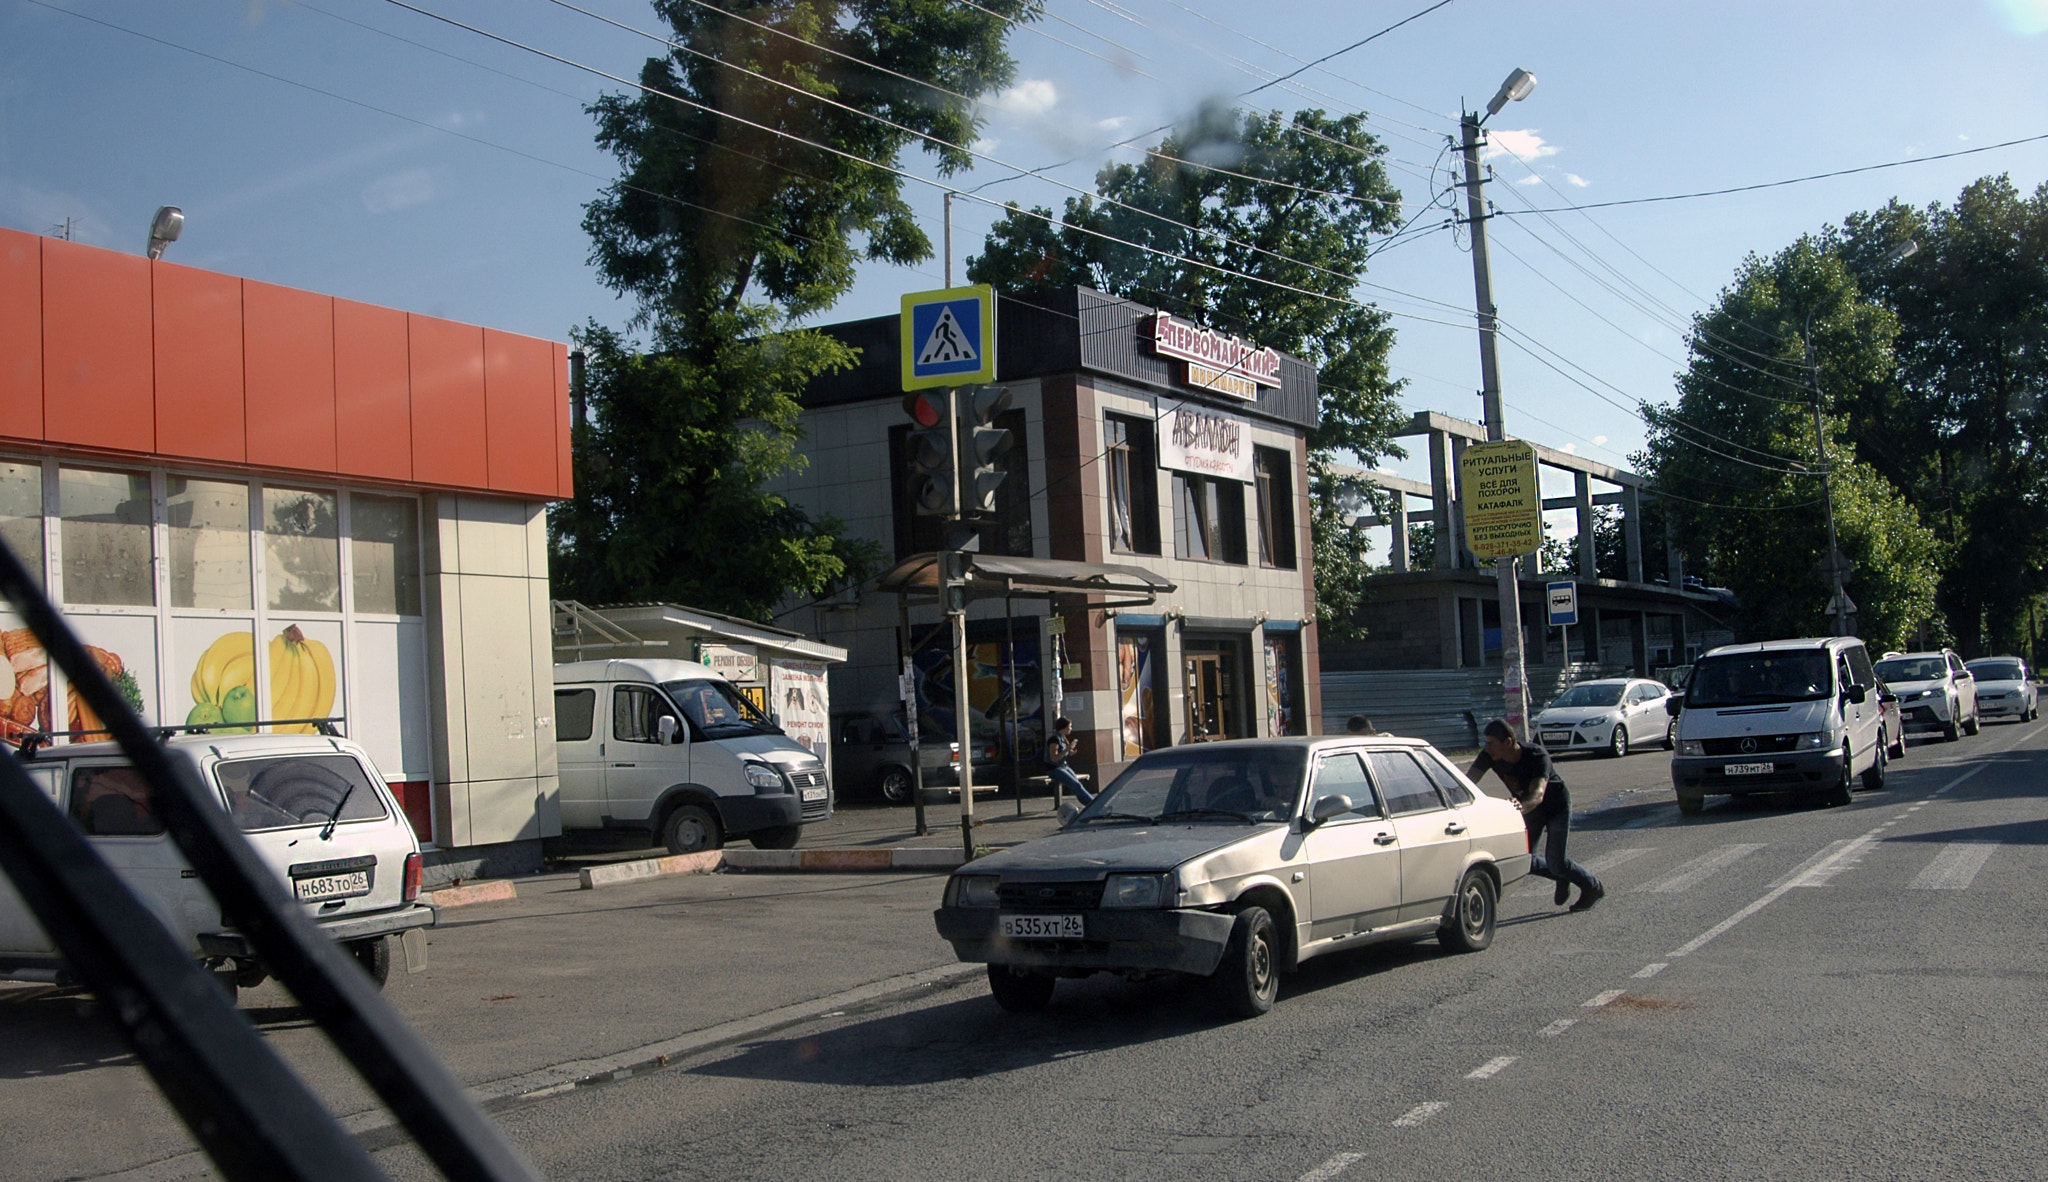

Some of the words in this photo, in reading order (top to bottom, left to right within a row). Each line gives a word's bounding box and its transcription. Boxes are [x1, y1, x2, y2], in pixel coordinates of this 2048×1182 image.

[1168, 324, 1272, 376] ПЕРВОМАЙСКИЙ
[1191, 366, 1255, 399] МИНИМАРКЕТ
[1172, 407, 1239, 459] АВАЛЛОН
[1463, 452, 1531, 467] РИТУАЛЬНЫЕ
[1479, 465, 1517, 477] УСЛУГИ
[1500, 479, 1518, 488] ДЛЯ
[1478, 487, 1521, 498] ПОХОРОН
[1478, 499, 1524, 511] КАТАФАЛК
[1473, 522, 1532, 534] КРУГЛОСУТОЧНО
[1490, 529, 1531, 539] ВЫХОДНЫХ
[714, 656, 735, 667] РЕМОНТ
[352, 873, 364, 885] 26
[1064, 917, 1079, 930] 26
